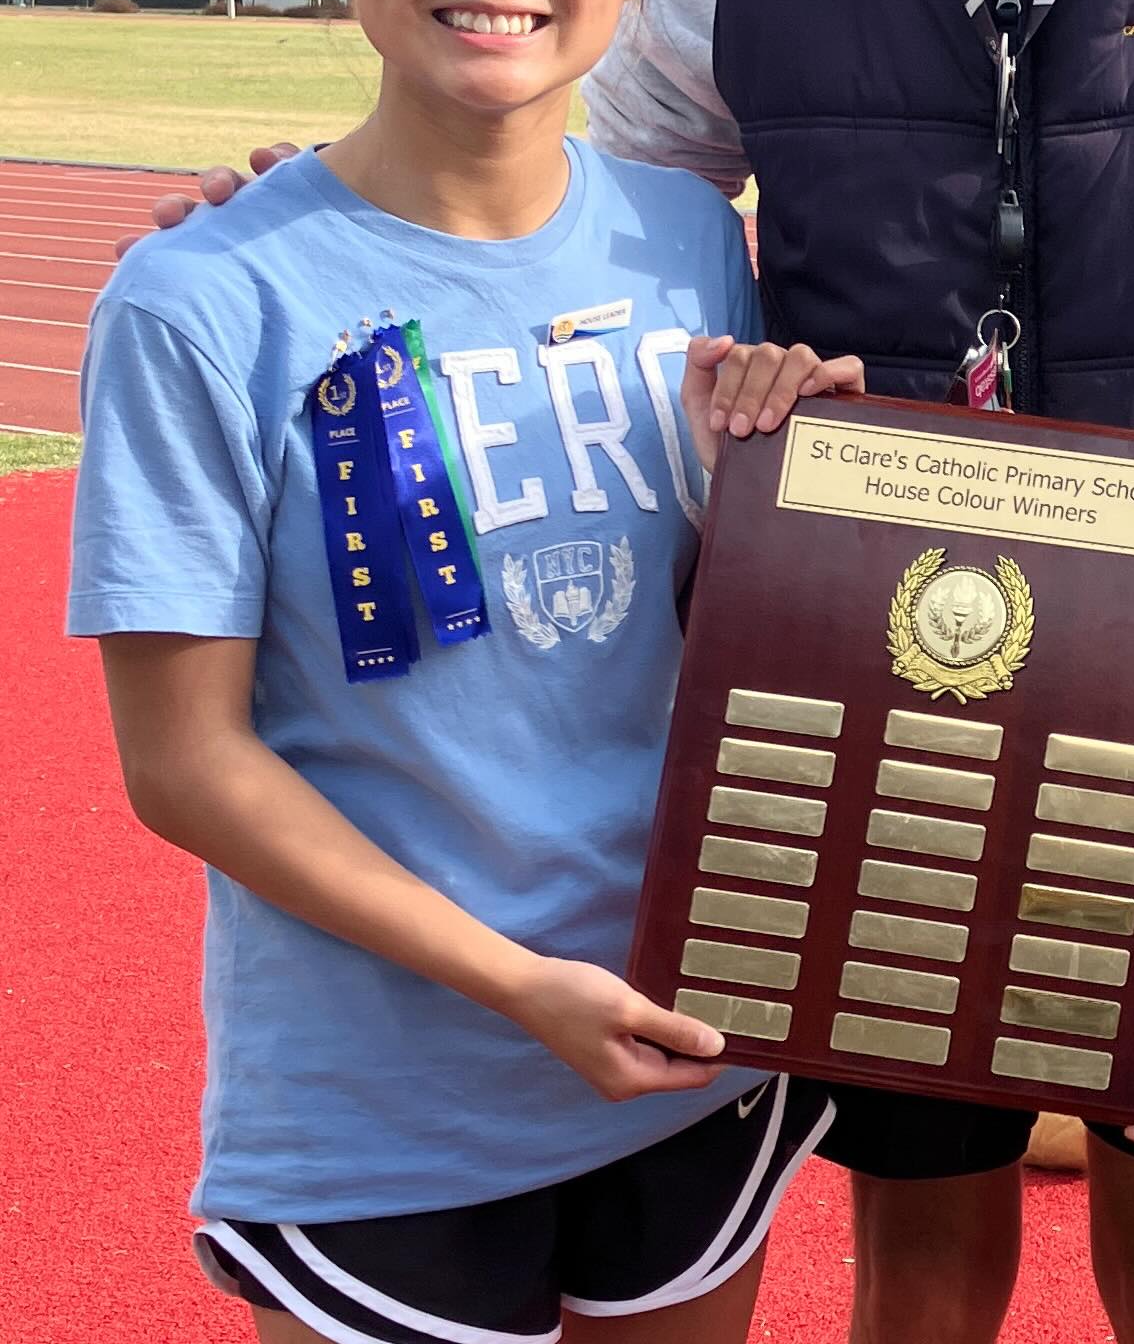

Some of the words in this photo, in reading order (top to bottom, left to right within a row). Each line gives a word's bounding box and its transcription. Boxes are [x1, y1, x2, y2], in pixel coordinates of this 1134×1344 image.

[381, 396, 411, 412] PLACE
[329, 427, 356, 440] PLACE
[810, 440, 832, 461] St
[839, 443, 908, 471] Clare's
[915, 453, 999, 483] Catholic
[1005, 466, 1086, 498] Primary
[398, 428, 457, 585] FIRST
[865, 475, 930, 503] House
[937, 486, 1005, 513] Colour
[1012, 495, 1098, 525] Winners
[337, 460, 377, 622] FIRST
[543, 546, 594, 579] NYC
